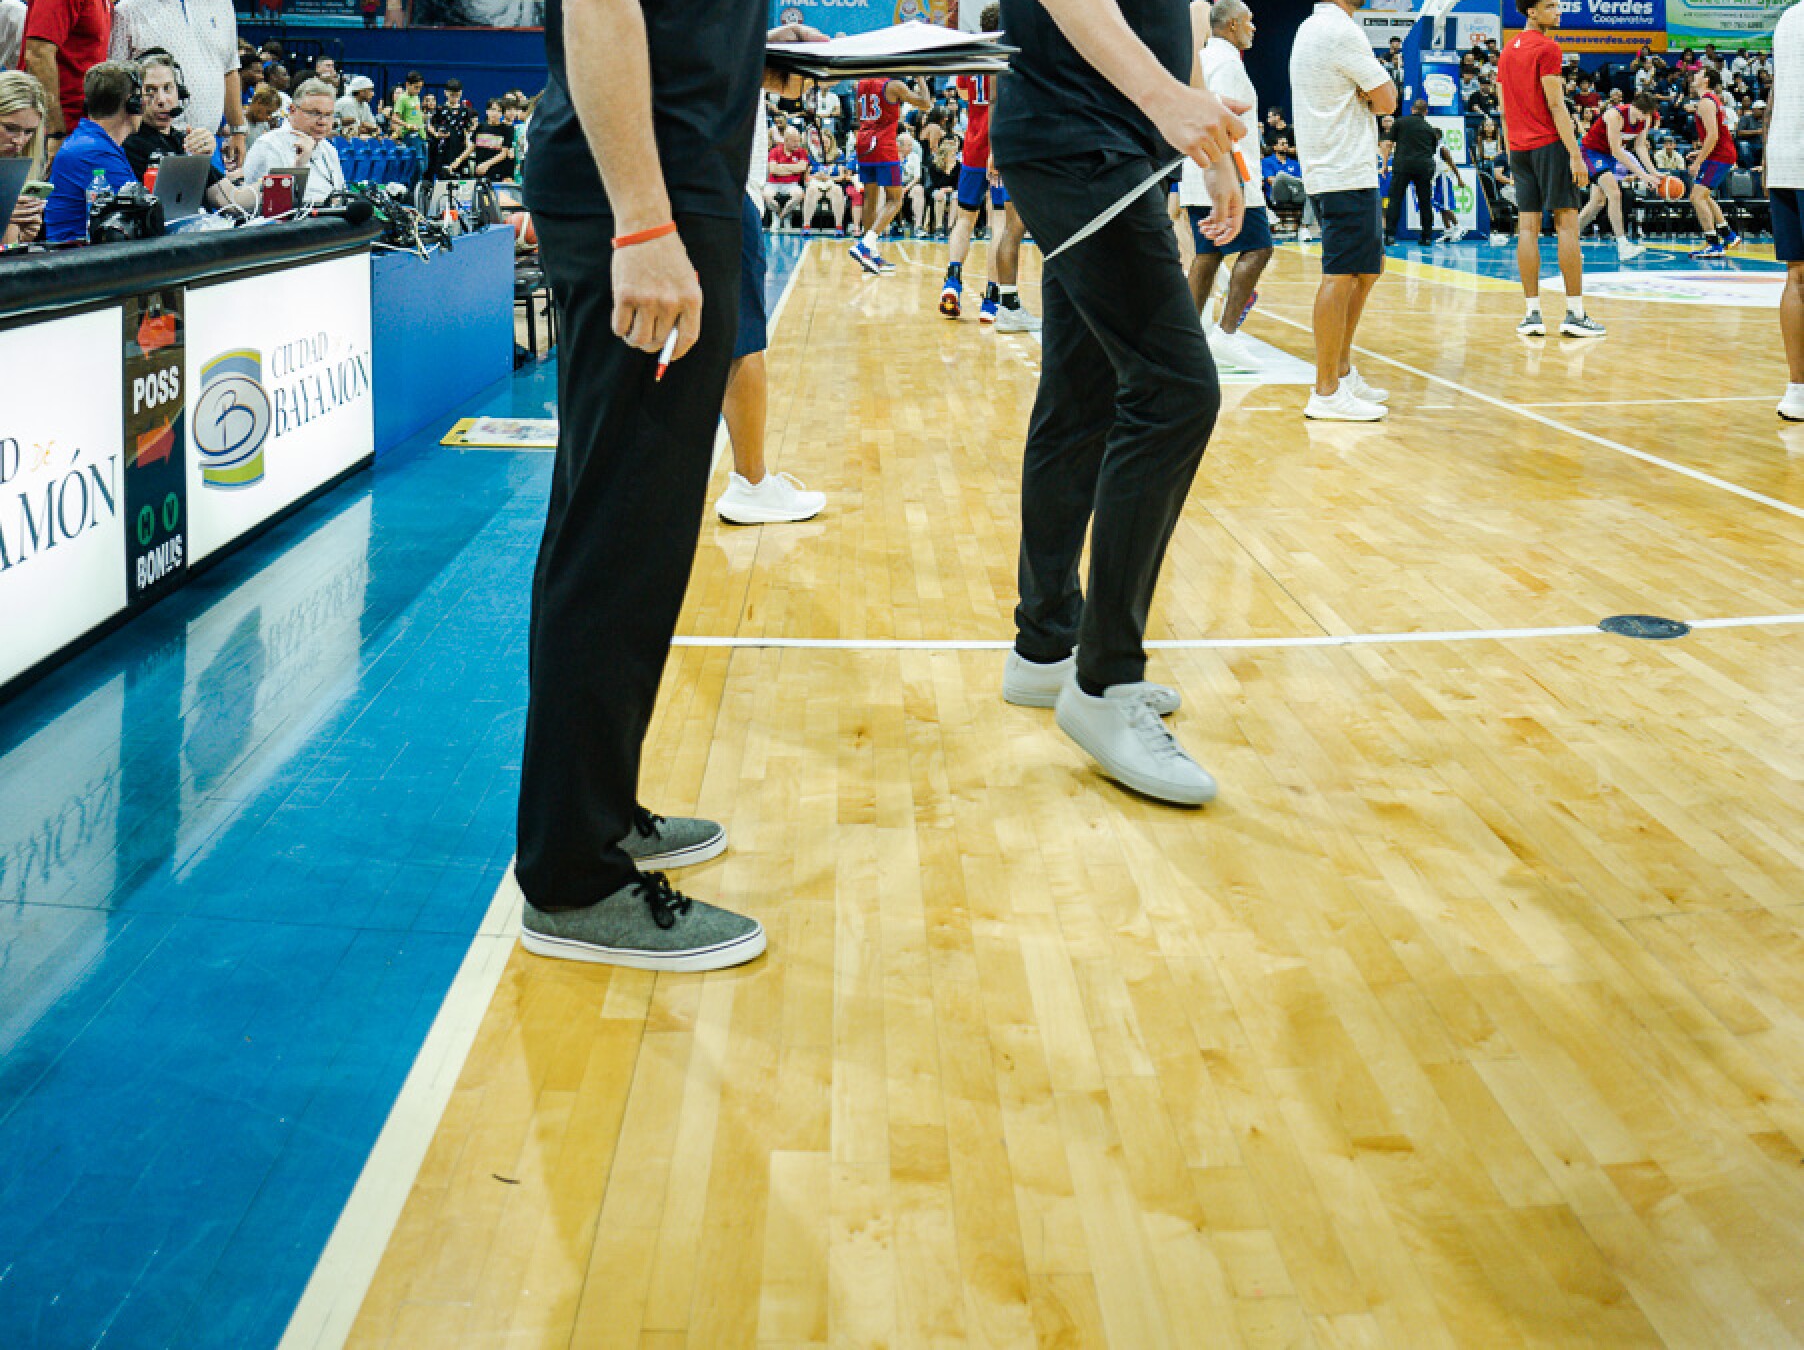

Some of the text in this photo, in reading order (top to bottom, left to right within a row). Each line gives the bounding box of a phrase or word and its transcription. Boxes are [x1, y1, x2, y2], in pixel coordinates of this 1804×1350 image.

[858, 93, 882, 121] 13
[272, 332, 329, 378] CIUDAD
[133, 365, 179, 415] POSS
[274, 344, 369, 438] BAYAMÓN
[136, 533, 183, 589] BONUS
